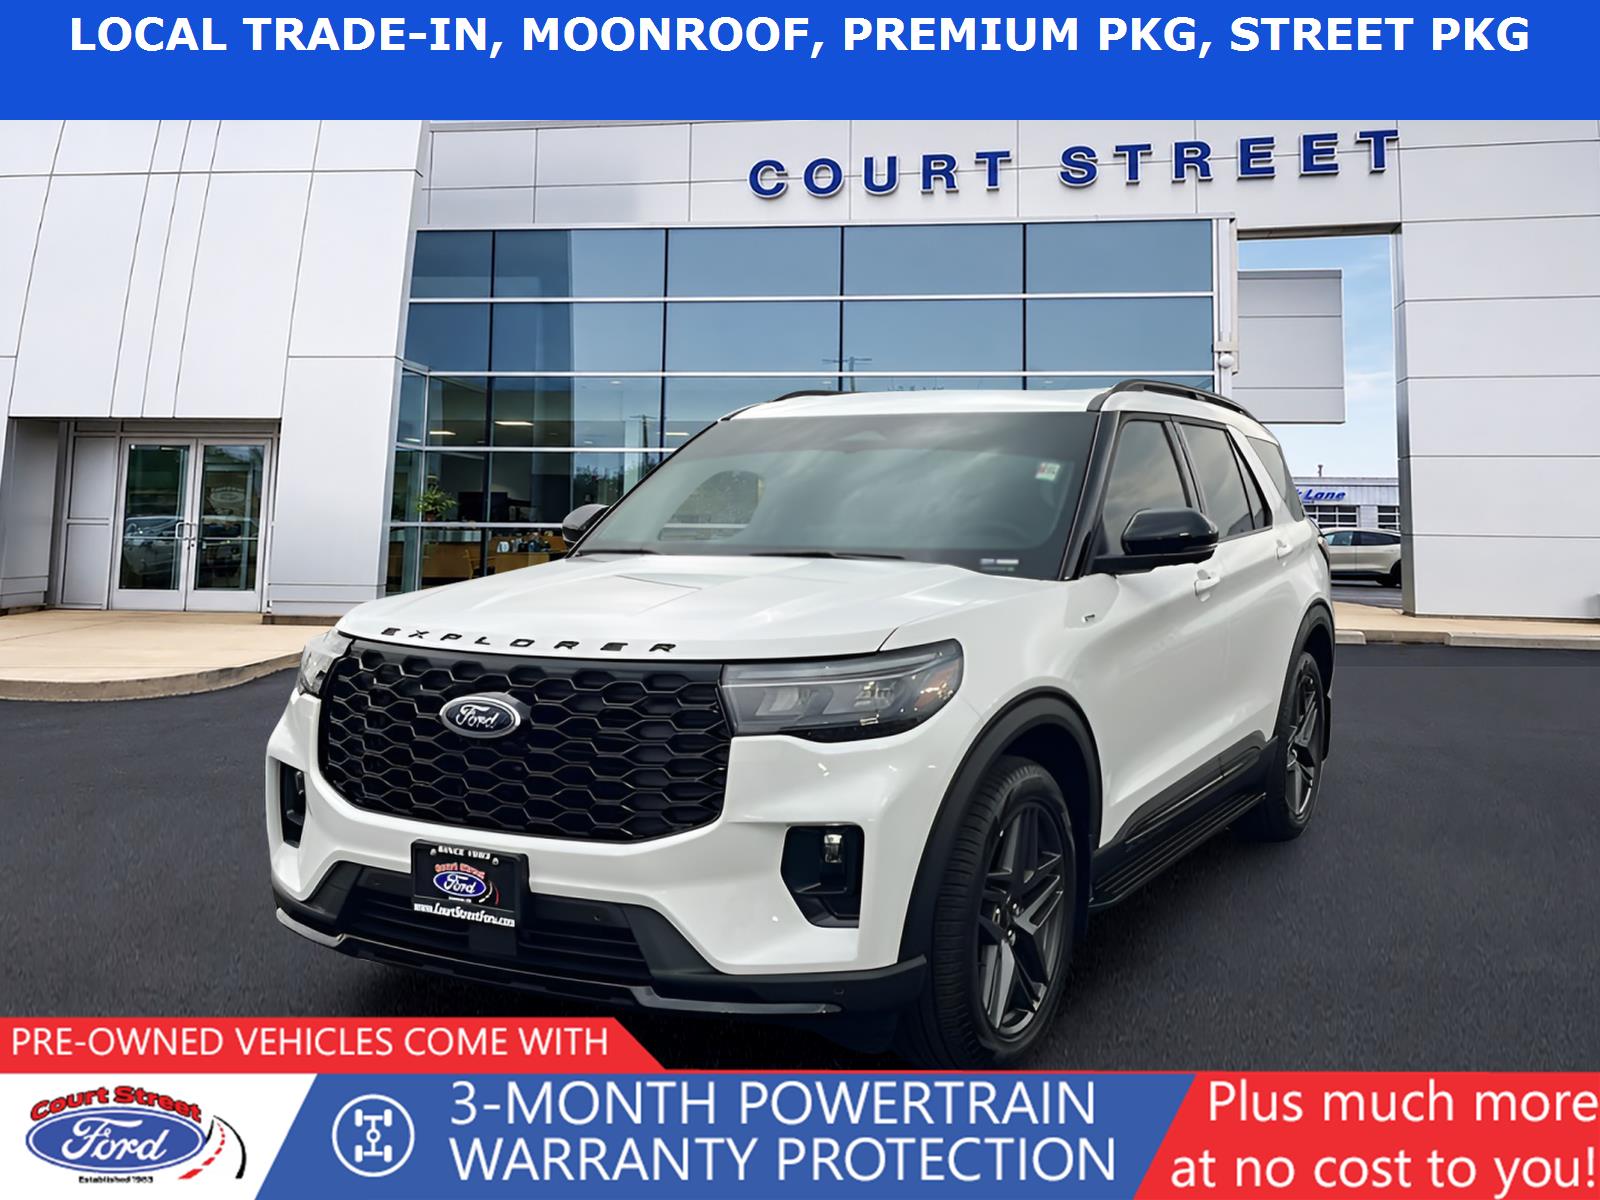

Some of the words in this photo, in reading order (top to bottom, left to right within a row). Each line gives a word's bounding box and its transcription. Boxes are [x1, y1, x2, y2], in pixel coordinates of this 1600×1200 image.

[748, 149, 1013, 198] COURT
[1058, 128, 1400, 187] STREET
[1303, 489, 1347, 501] Lane
[381, 627, 676, 653] EXPLORER
[454, 703, 500, 729] Ford
[443, 873, 477, 894] Ford
